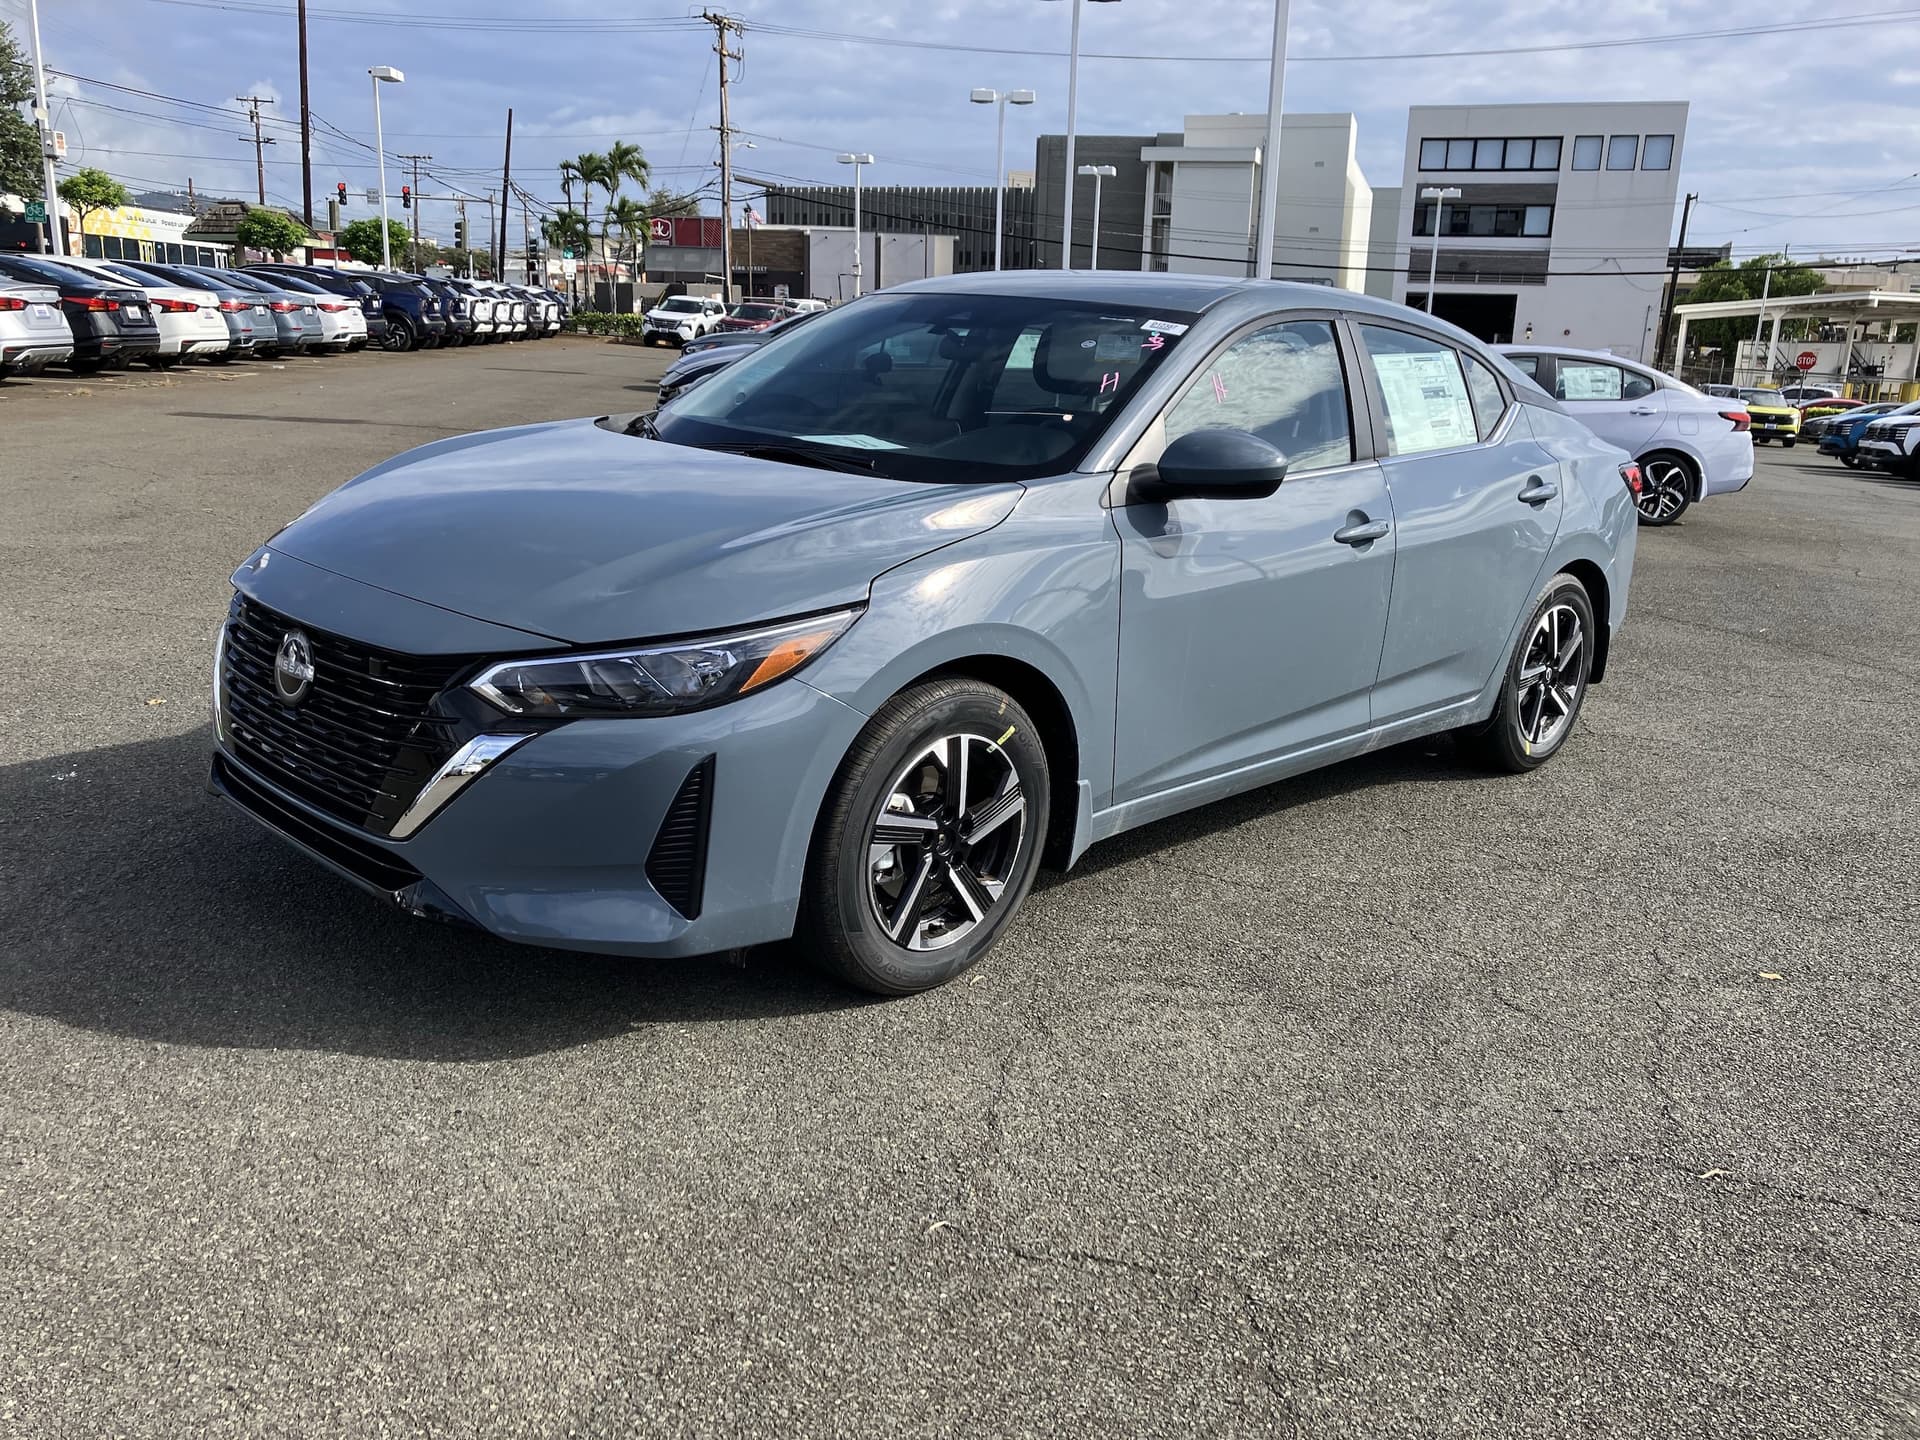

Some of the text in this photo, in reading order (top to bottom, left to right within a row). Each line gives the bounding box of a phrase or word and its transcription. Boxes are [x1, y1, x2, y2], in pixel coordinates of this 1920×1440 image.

[1797, 356, 1816, 365] STOP
[1100, 371, 1120, 393] H
[279, 655, 310, 679] NISSAN
